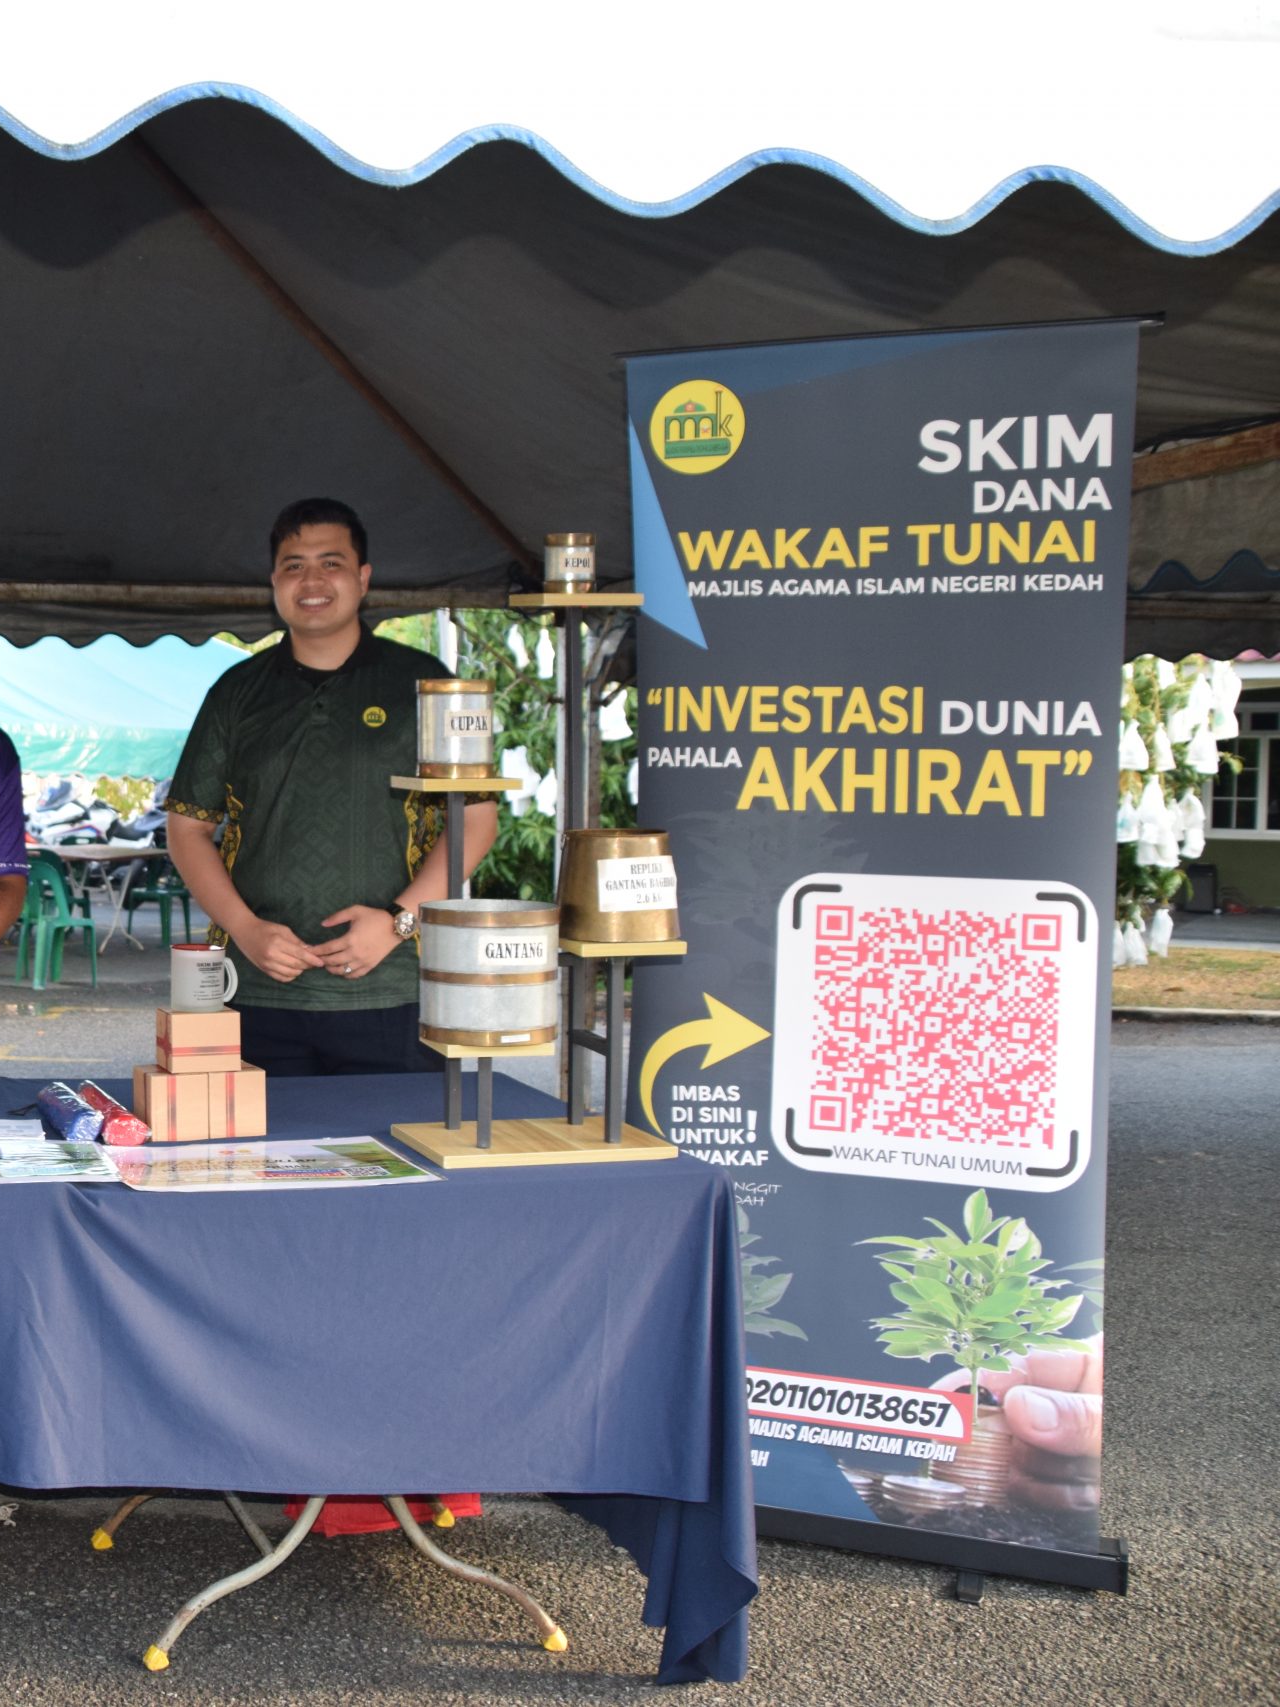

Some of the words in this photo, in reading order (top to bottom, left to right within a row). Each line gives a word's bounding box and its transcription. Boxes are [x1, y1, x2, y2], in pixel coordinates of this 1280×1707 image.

[918, 413, 1113, 473] SKIM
[973, 477, 1112, 514] DANA
[678, 525, 890, 571] WAKAF
[906, 519, 1096, 566] TUNAI
[687, 579, 763, 598] MAJLIS
[768, 577, 851, 597] AGAMA
[857, 576, 925, 595] ISLAM
[932, 575, 1017, 594] NEGERI
[1024, 573, 1104, 592] KEDAH
[450, 715, 488, 731] CUPAK
[940, 700, 1102, 736] DUNIA
[648, 746, 743, 768] PAHALA
[605, 879, 647, 891] GANTANG
[485, 942, 543, 959] GANTANG
[672, 1085, 741, 1102] IMBAS
[672, 1107, 693, 1122] DI
[699, 1107, 742, 1123] SINI
[671, 1128, 745, 1144] UNTUK
[833, 1145, 897, 1162] WAKAF
[901, 1151, 956, 1169] TUNAI
[960, 1157, 1023, 1175] UMUM
[797, 1425, 853, 1449] AGAMA
[855, 1433, 903, 1455] ISLAM
[905, 1440, 957, 1462] KEDAH
